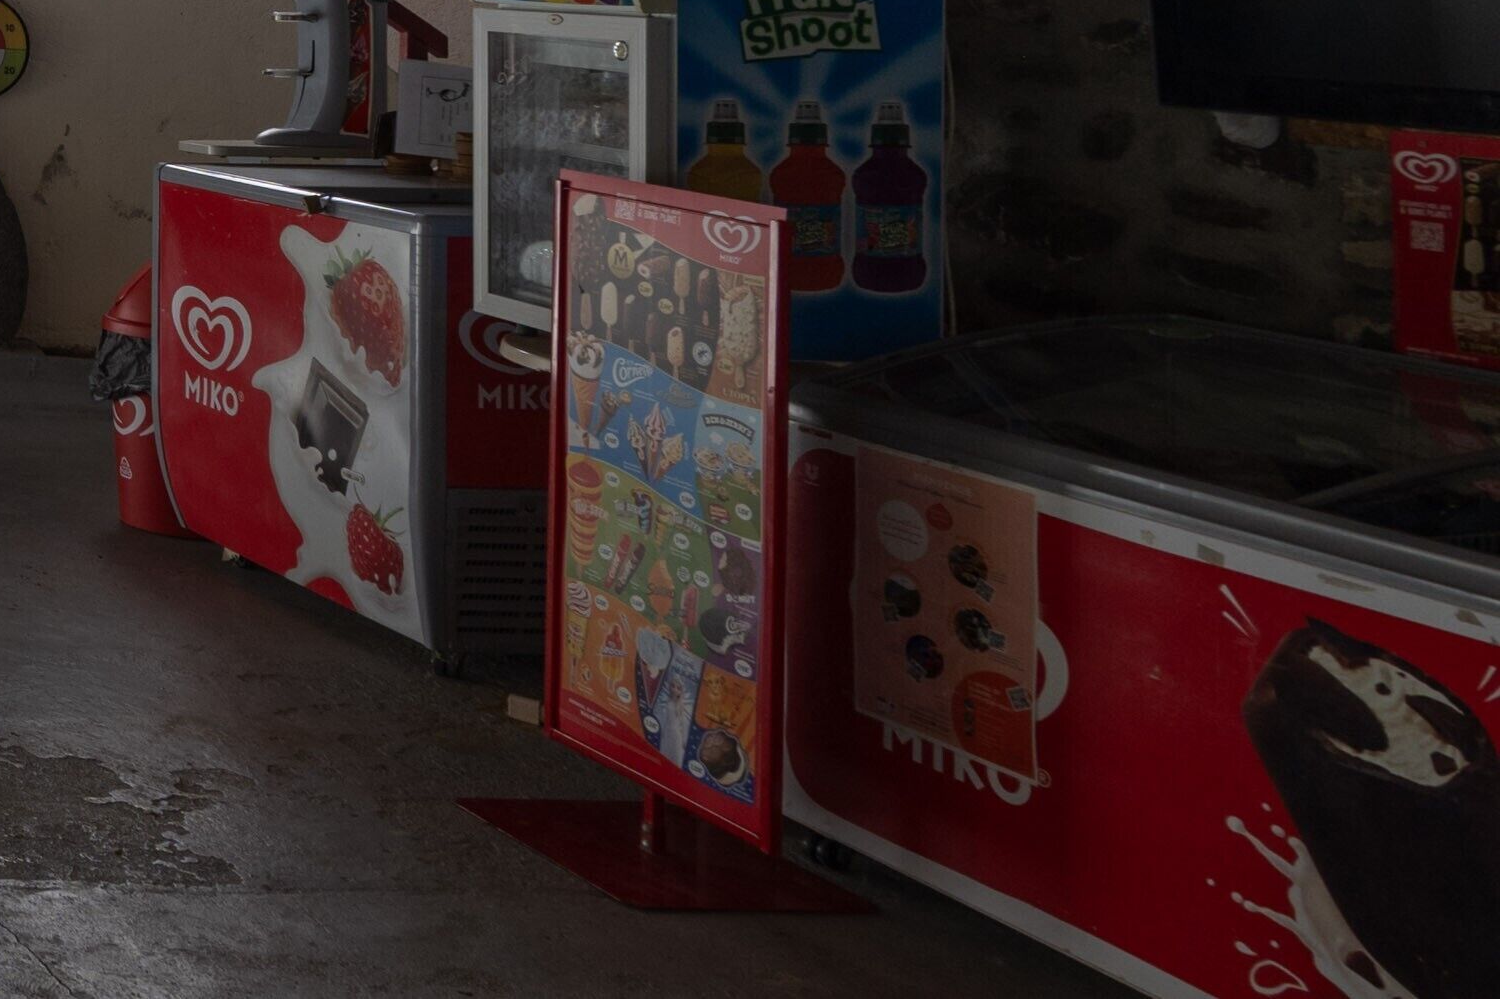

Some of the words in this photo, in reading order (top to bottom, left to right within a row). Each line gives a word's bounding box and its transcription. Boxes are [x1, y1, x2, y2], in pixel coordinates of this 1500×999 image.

[5, 23, 15, 32] 10
[745, 9, 873, 56] Shoot
[4, 66, 15, 75] 20
[184, 370, 240, 417] MIKO
